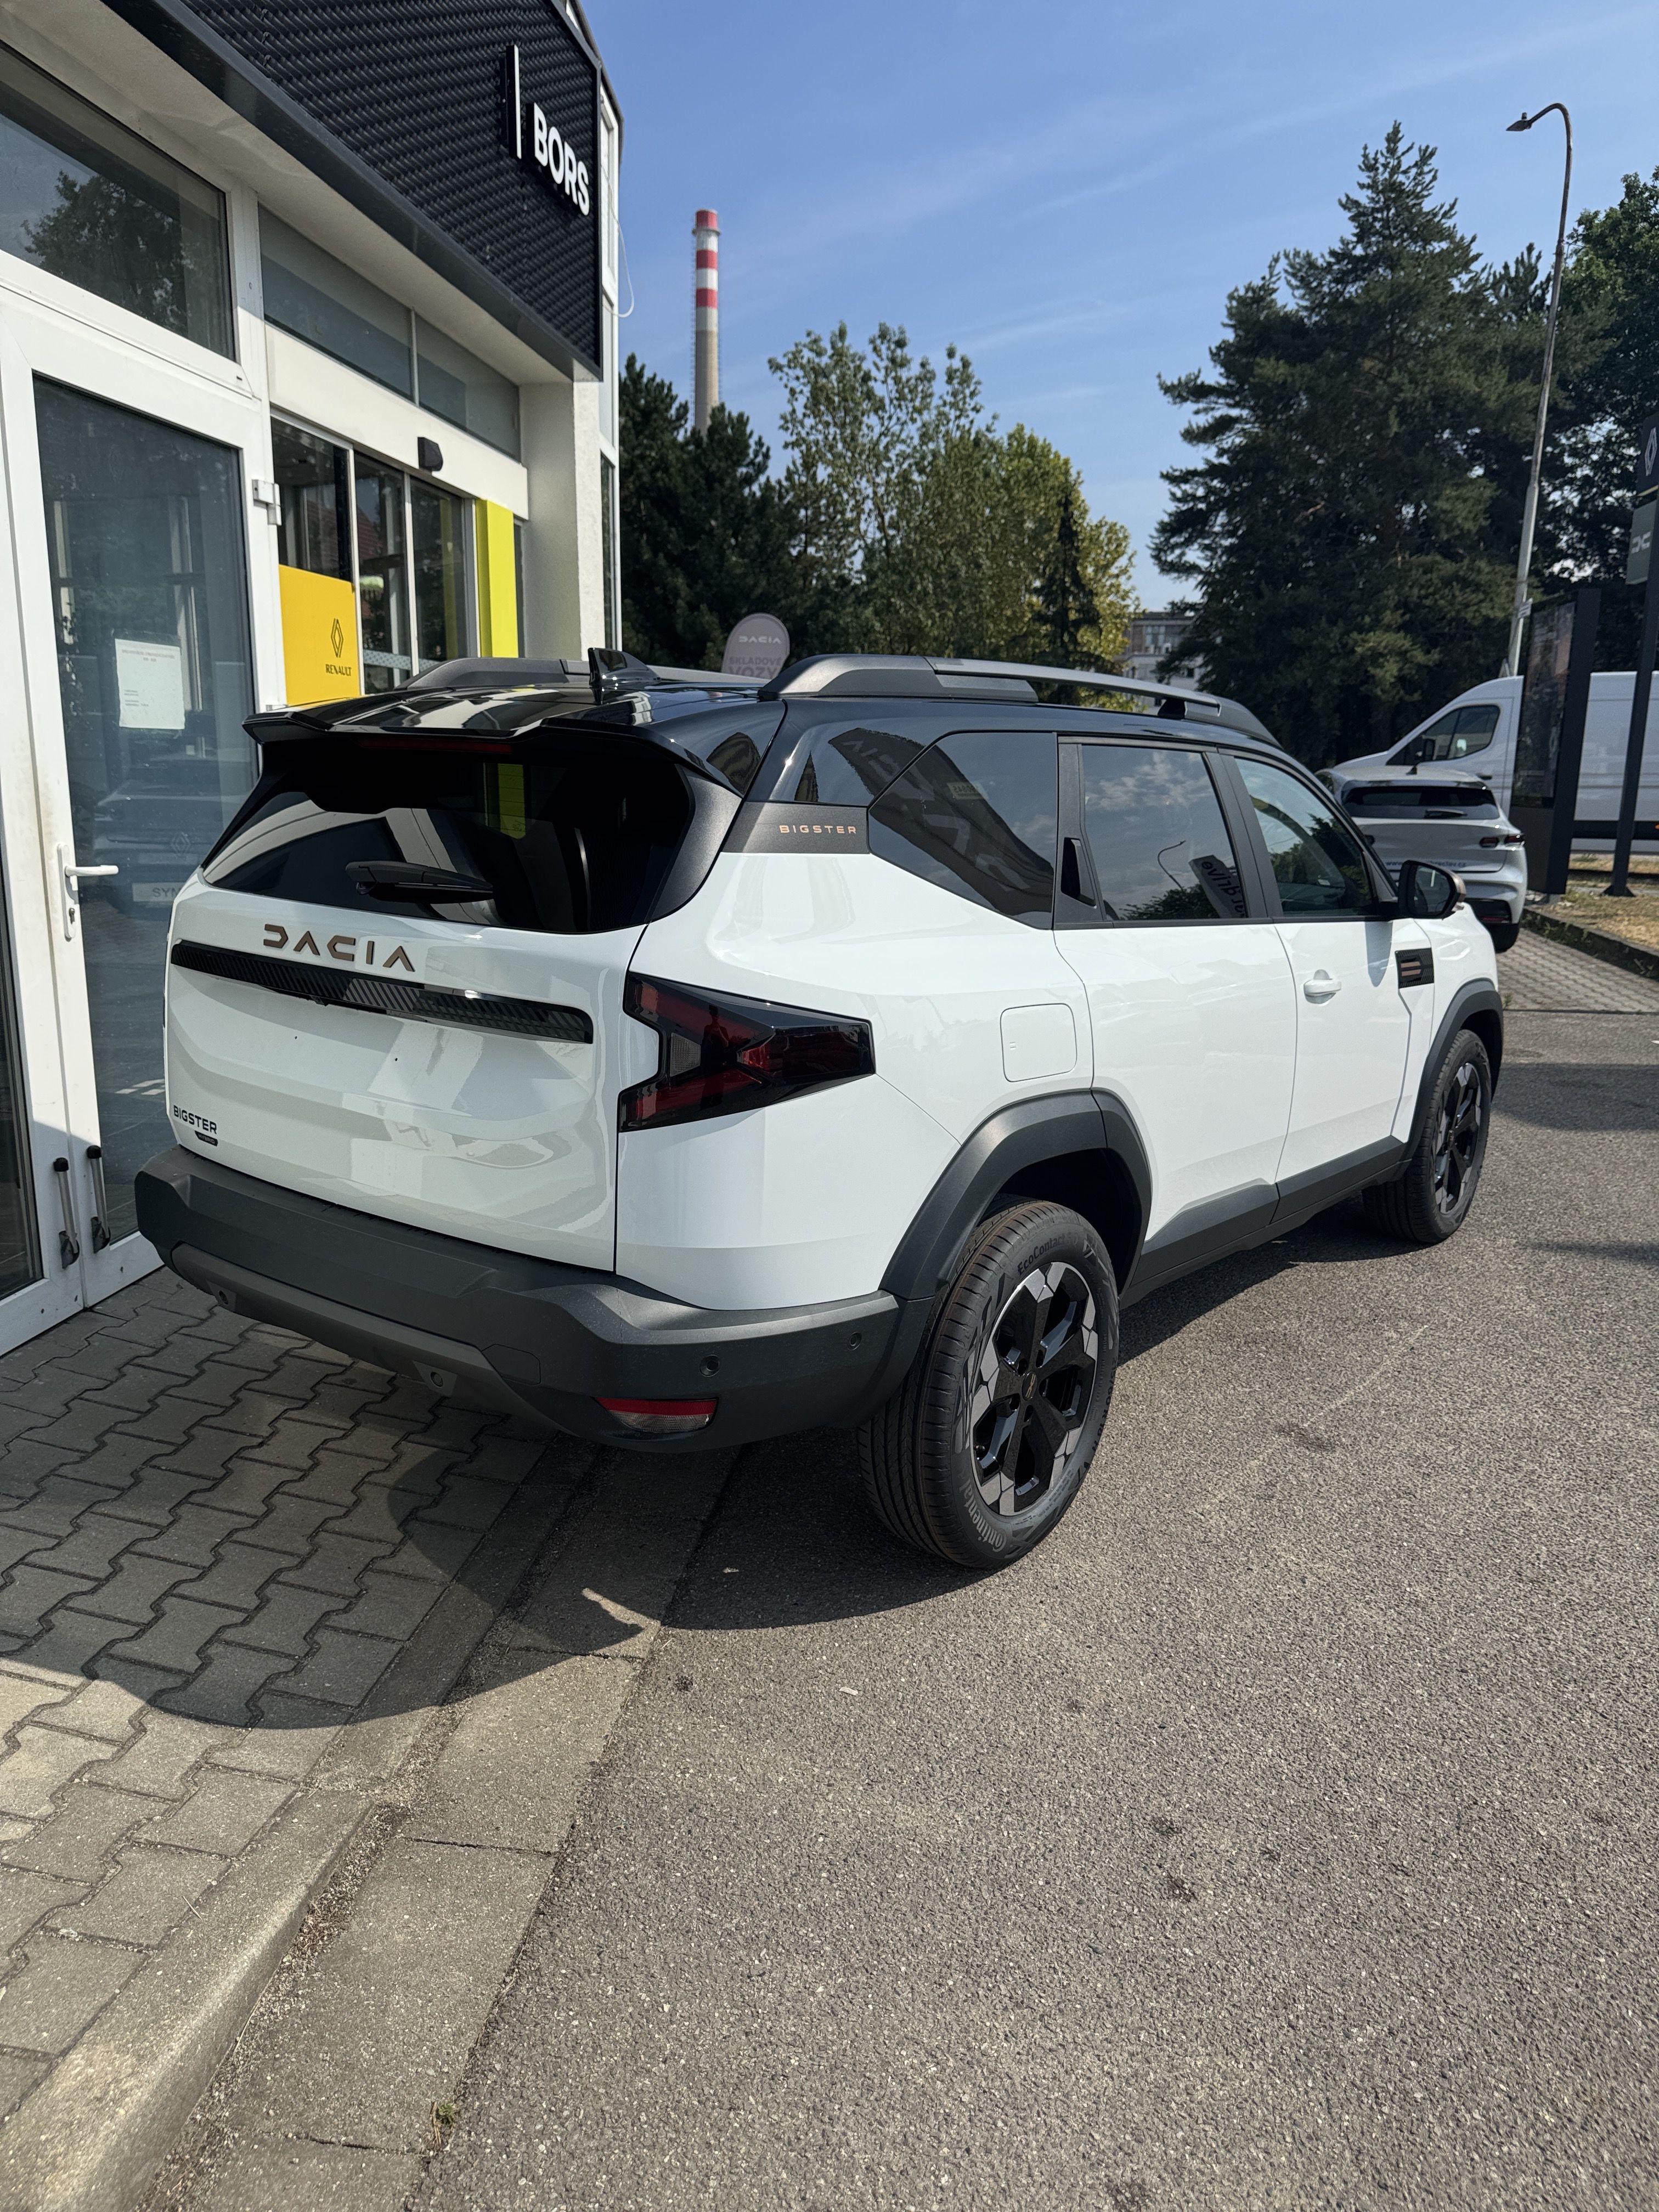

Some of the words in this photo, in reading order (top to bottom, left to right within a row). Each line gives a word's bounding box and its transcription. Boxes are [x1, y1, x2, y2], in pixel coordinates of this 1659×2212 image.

[533, 103, 590, 216] BORS
[738, 635, 782, 644] DACIA
[325, 664, 352, 676] RENAULT
[778, 825, 857, 834] BIGSTER
[263, 923, 416, 972] DACIA
[173, 1105, 217, 1135] BIGSTER
[1017, 1233, 1065, 1276] EcoContact
[959, 1478, 1007, 1553] Continental
